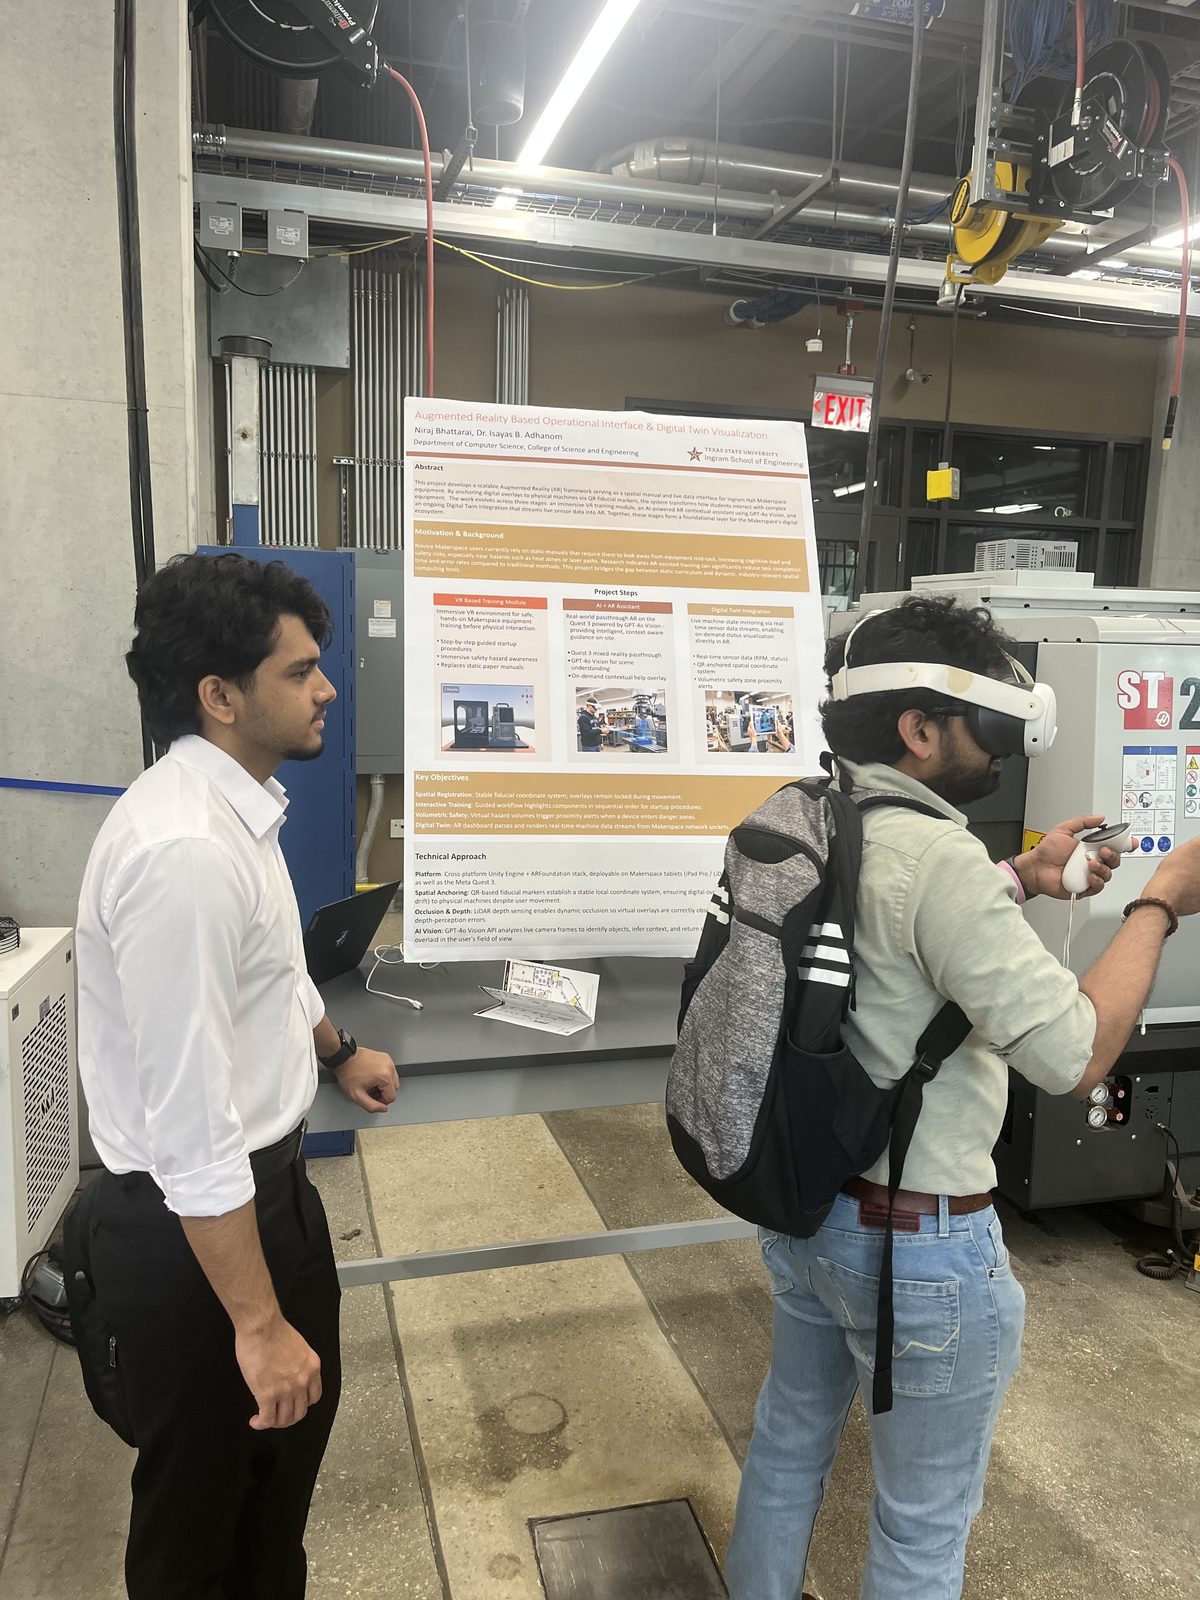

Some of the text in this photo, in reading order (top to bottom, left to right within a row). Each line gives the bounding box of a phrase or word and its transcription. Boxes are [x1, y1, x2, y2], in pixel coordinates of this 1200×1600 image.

[824, 394, 866, 428] EXIT
[415, 410, 768, 439] Augmented Reality Based Operational Interface & Digital Twin Visualization
[414, 426, 433, 435] Niraj
[435, 427, 474, 436] Bhattarai,
[489, 429, 512, 438] Isayas
[524, 431, 563, 440] Adhanom
[413, 438, 454, 446] Department
[464, 441, 497, 449] Computer
[499, 442, 526, 451] Science,
[527, 444, 551, 452] College
[601, 448, 640, 457] Engineering
[705, 454, 729, 462] Ingram
[730, 455, 753, 464] School
[763, 458, 804, 468] Engineering
[415, 528, 454, 537] Motivation
[462, 530, 504, 539] Background
[594, 588, 638, 597] Project Steps
[1117, 670, 1200, 729] ST 2
[415, 773, 469, 782] Key Objectives
[451, 853, 487, 861] Approach
